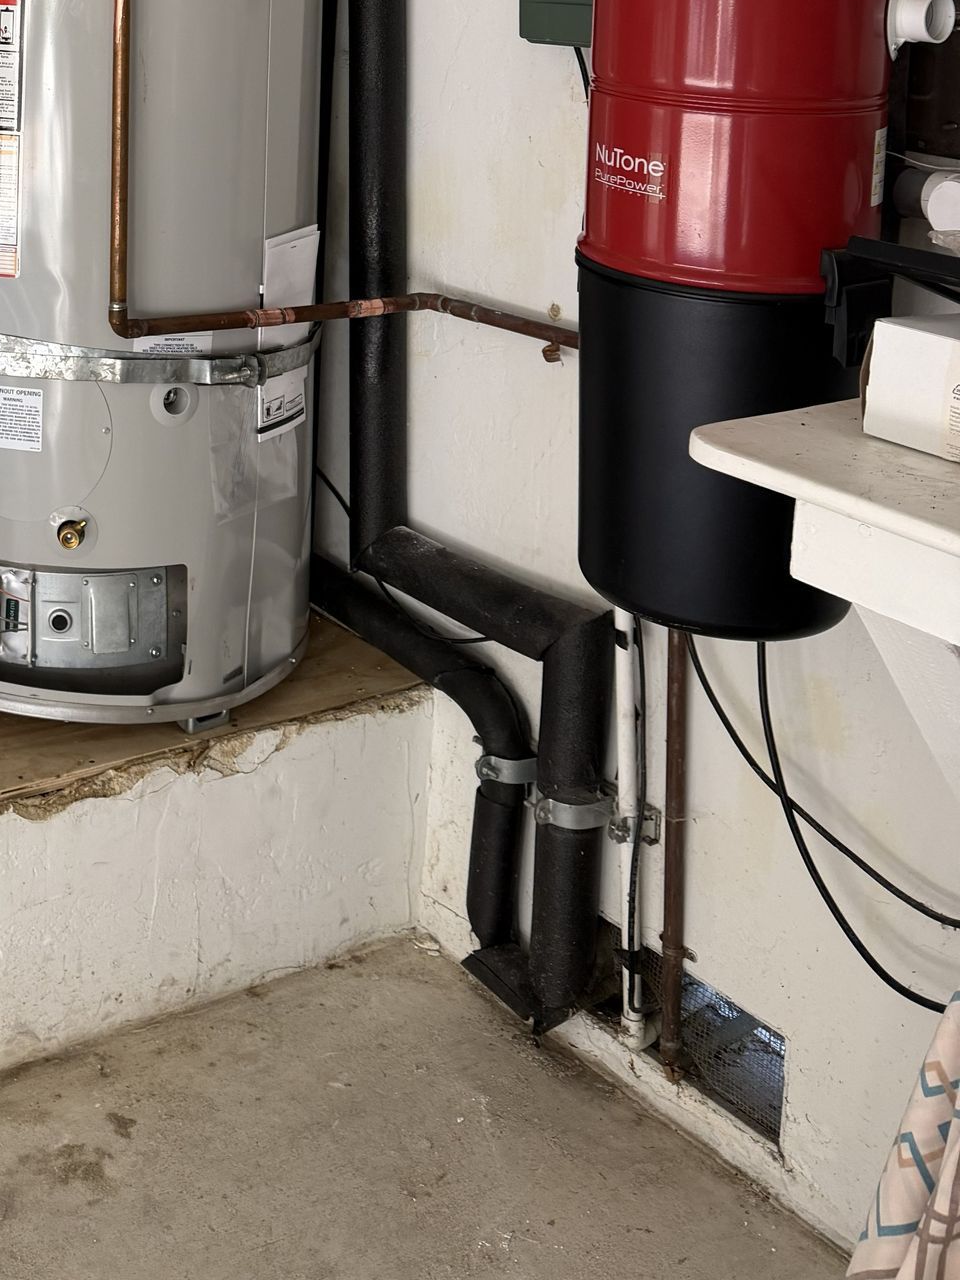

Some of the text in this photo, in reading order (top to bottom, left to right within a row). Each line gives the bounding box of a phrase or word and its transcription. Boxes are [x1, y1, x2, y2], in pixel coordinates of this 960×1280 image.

[595, 142, 664, 176] NuTone
[595, 168, 662, 194] PurePower
[15, 389, 41, 397] OPENING
